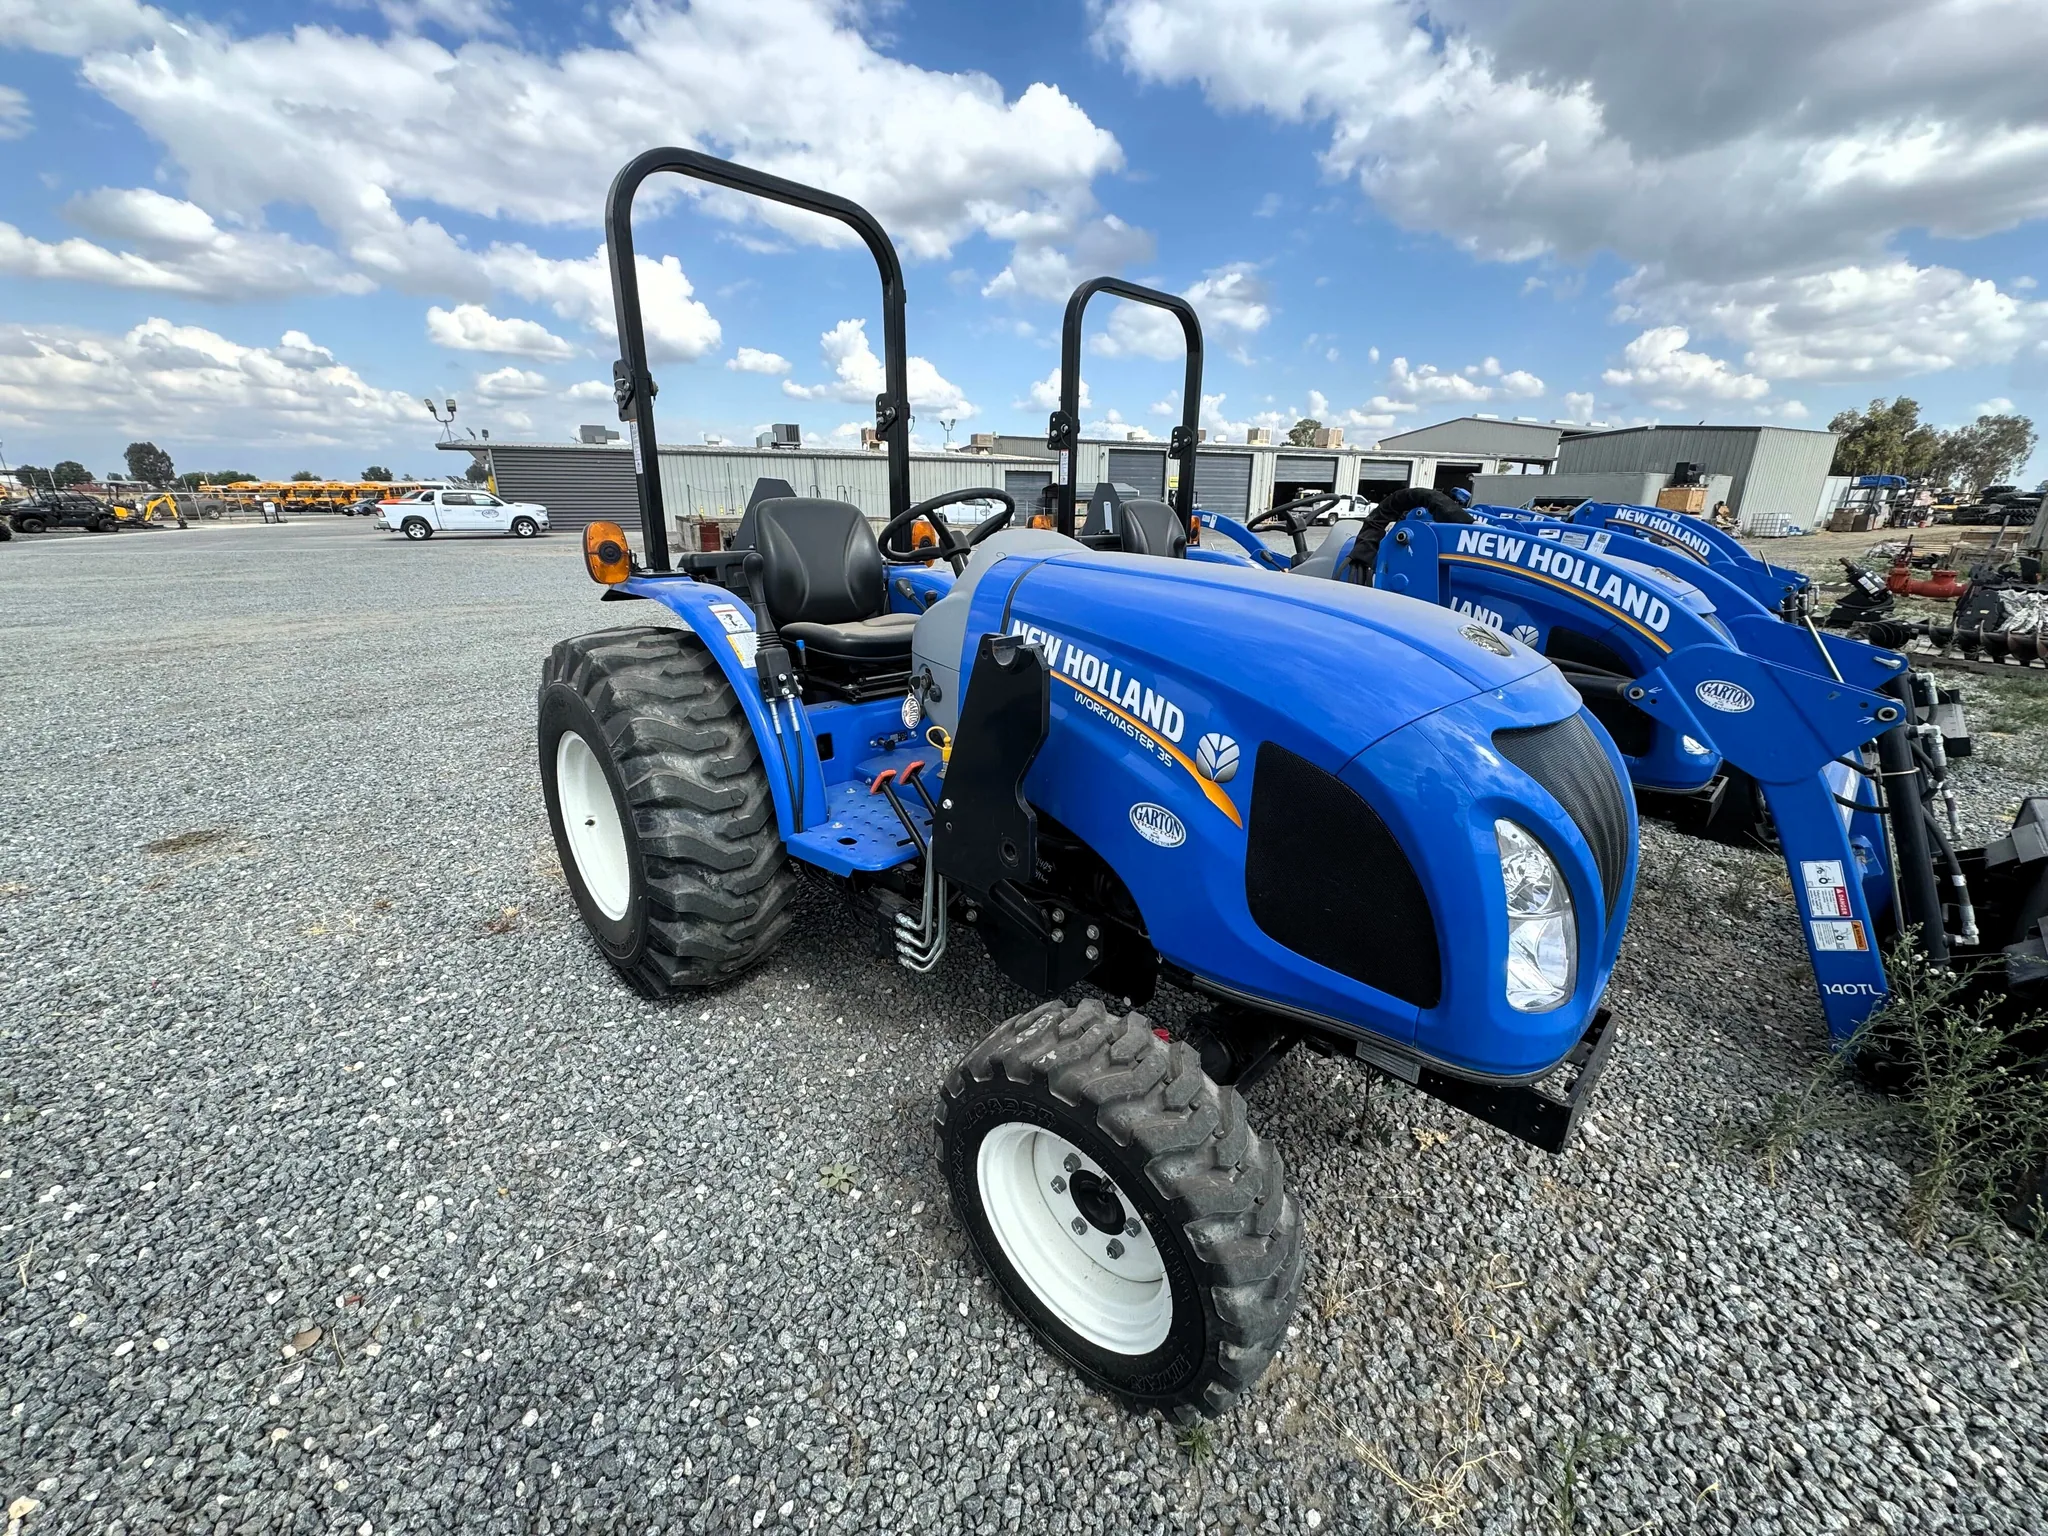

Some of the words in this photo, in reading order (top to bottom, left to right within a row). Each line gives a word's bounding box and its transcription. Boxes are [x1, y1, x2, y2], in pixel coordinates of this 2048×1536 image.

[1614, 507, 1646, 525] NEW
[1648, 516, 1711, 557] HOLLAND
[1456, 529, 1527, 563] NEW
[1527, 547, 1671, 634] HOLLAND
[1062, 643, 1185, 744] HOLLAND
[1701, 681, 1752, 707] GARTON
[1074, 691, 1155, 753] WORKMASTER
[1156, 746, 1173, 768] 35
[1133, 805, 1182, 838] GARTON
[1838, 894, 1849, 915] DANGER
[1822, 983, 1884, 996] 140TL
